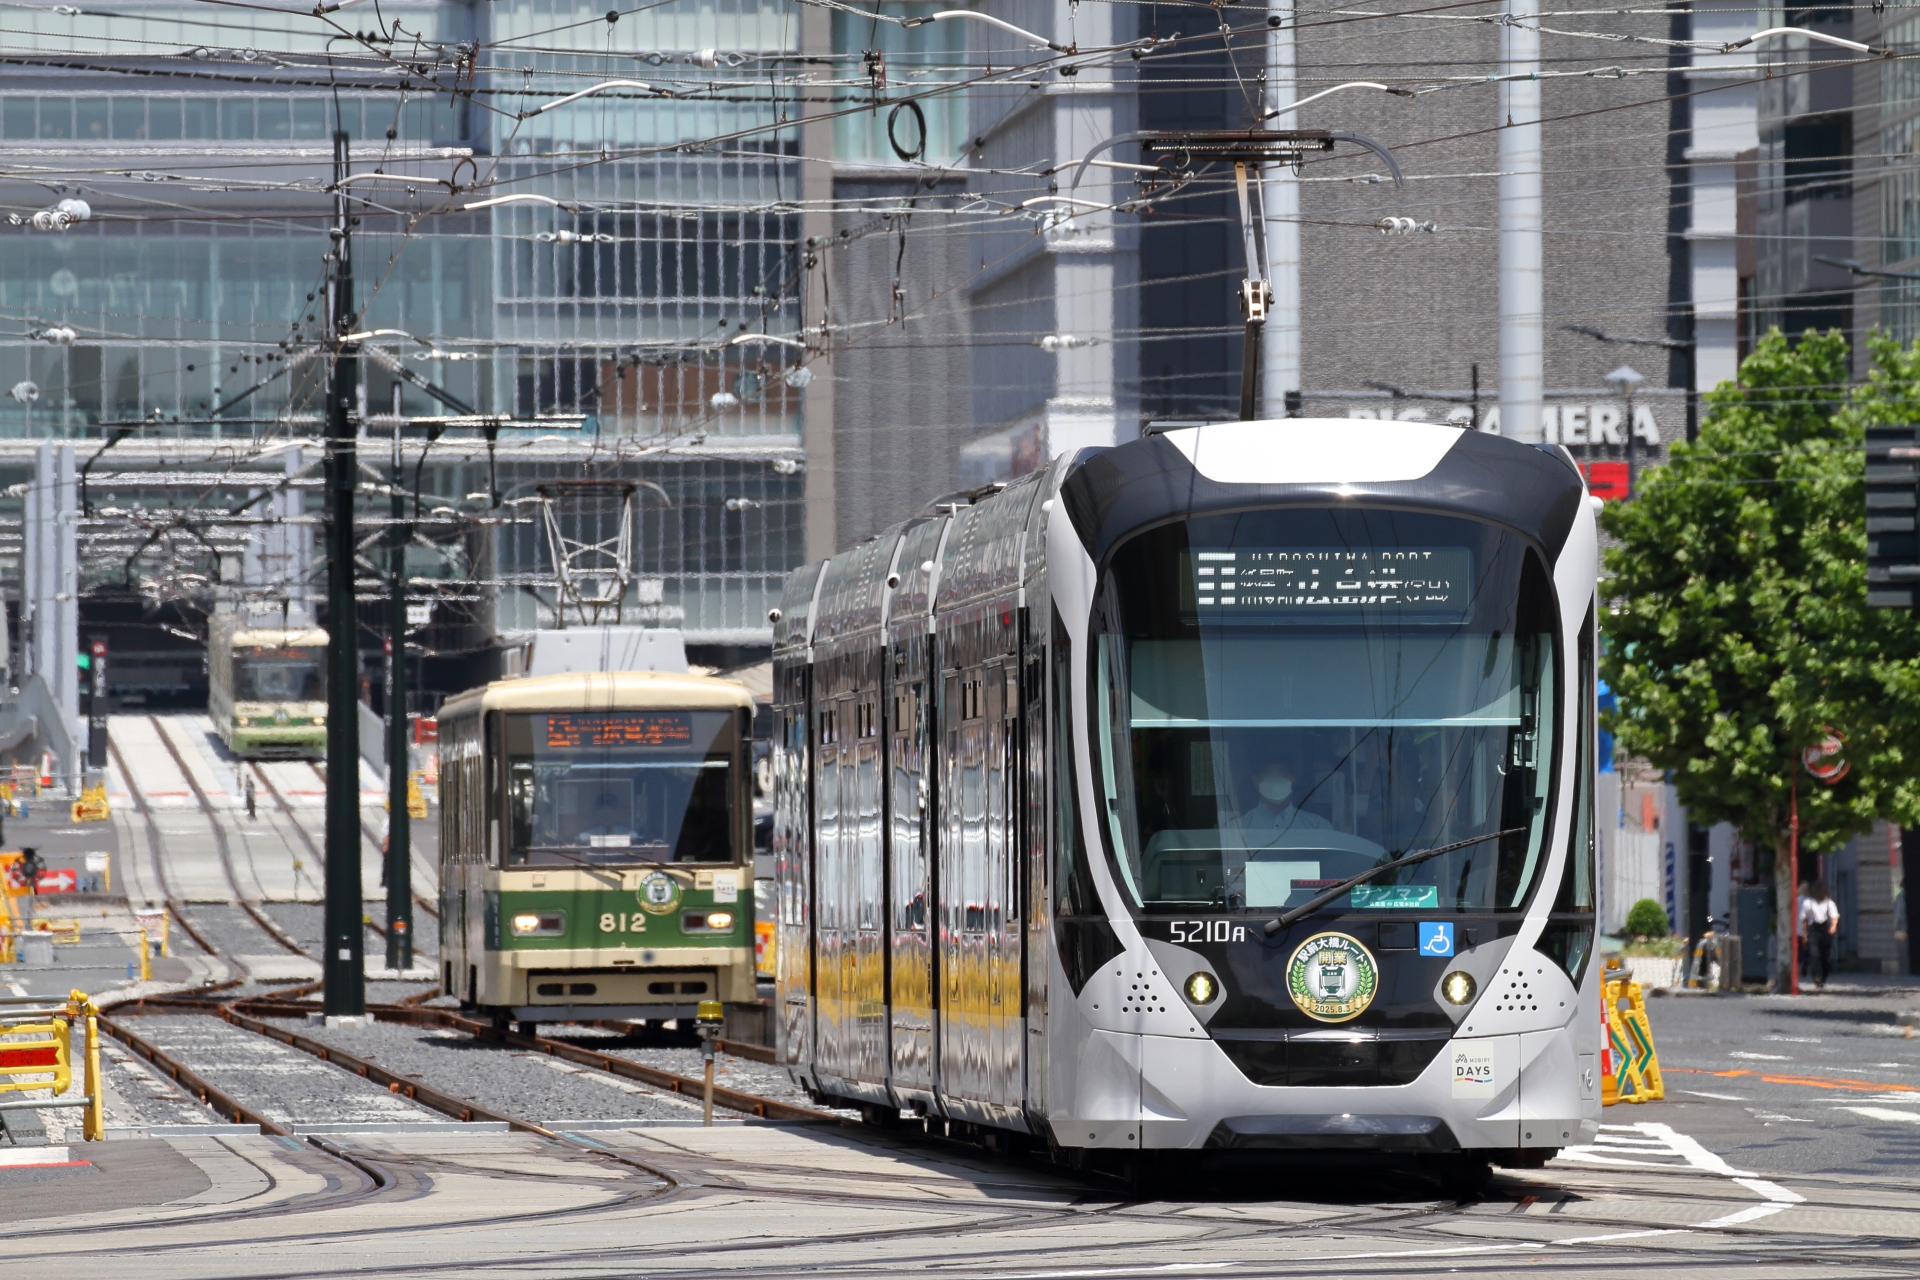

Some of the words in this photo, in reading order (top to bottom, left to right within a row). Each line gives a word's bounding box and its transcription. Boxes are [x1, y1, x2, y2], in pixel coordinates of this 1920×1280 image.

[1355, 887, 1433, 902] ワンマン
[599, 912, 647, 933] 812
[1169, 920, 1246, 943] 5210A
[1296, 936, 1366, 963] 駅前大橋ルート
[1318, 950, 1347, 966] 開業
[1314, 1004, 1351, 1013] 2025.8.3
[1456, 1066, 1490, 1076] DAYS
